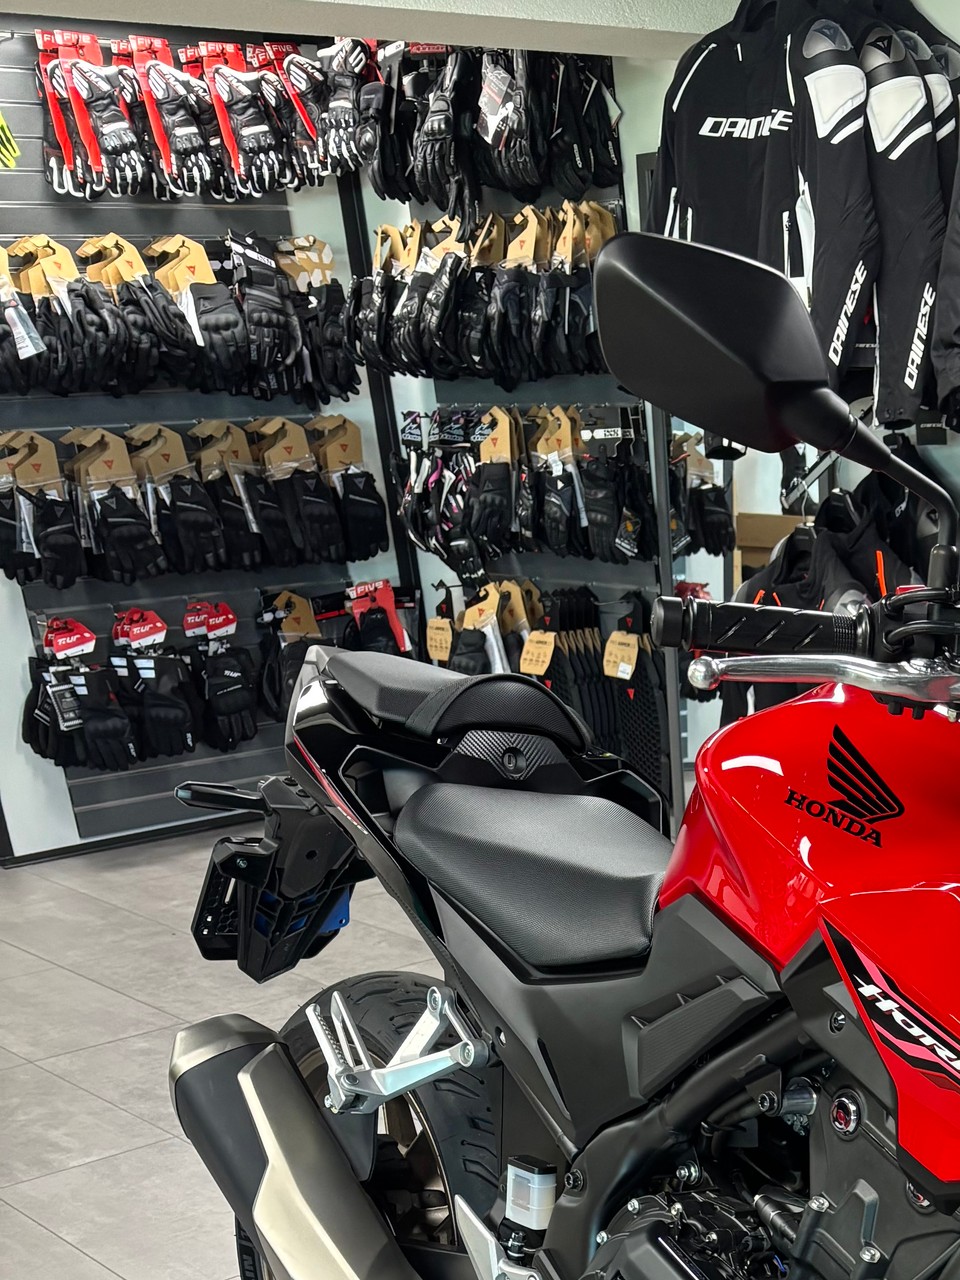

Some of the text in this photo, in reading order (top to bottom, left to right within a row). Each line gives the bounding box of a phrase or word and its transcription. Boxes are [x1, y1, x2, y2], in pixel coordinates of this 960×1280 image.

[829, 260, 867, 366] DAINESE
[904, 282, 936, 390] DAINESE
[784, 788, 883, 848] HONDA
